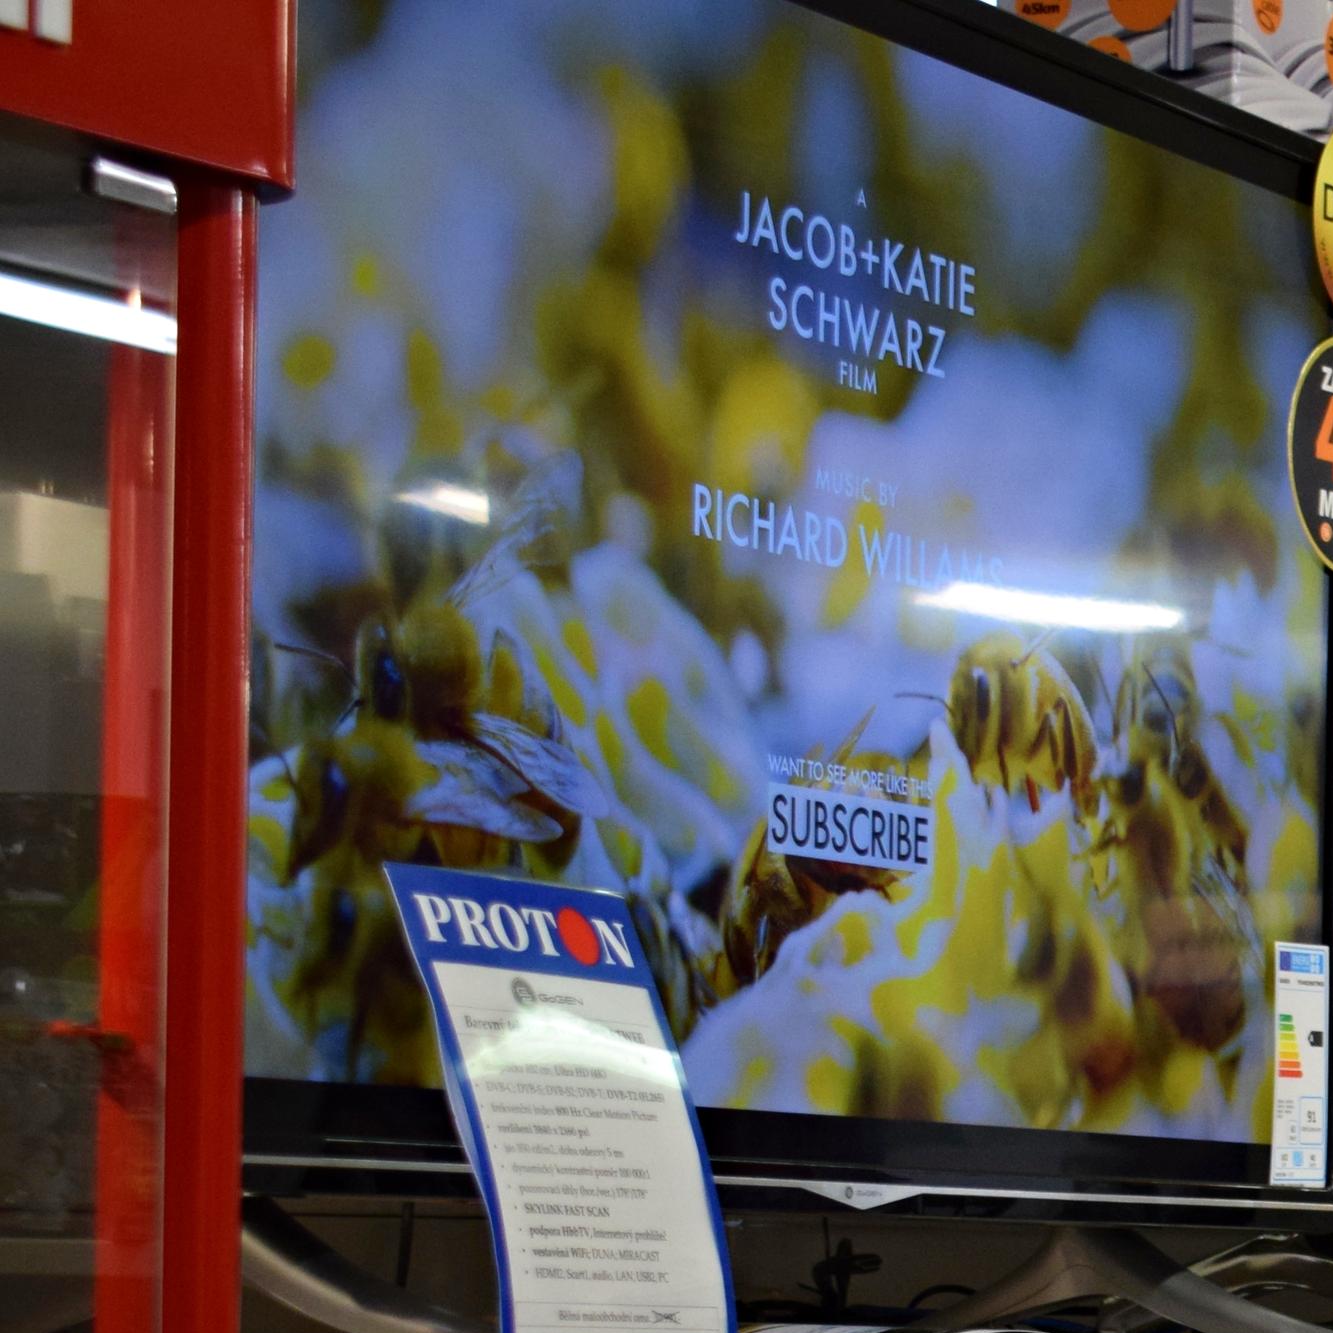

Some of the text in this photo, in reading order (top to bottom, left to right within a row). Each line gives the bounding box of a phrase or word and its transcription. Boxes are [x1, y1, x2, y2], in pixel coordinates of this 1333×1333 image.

[857, 188, 866, 208] A
[736, 191, 976, 316] JACOB+KATIE
[769, 276, 946, 378] SCHWARZ
[840, 360, 877, 395] FILM
[815, 468, 899, 508] MUSIC BY
[692, 483, 848, 568] RICHARD
[768, 753, 805, 778] WANT
[807, 760, 824, 781] TO
[827, 764, 846, 785] SEE
[850, 770, 884, 791] MORE
[886, 774, 908, 795] LIKE
[771, 793, 929, 865] SUBSCRIBE
[413, 894, 635, 968] PROTON
